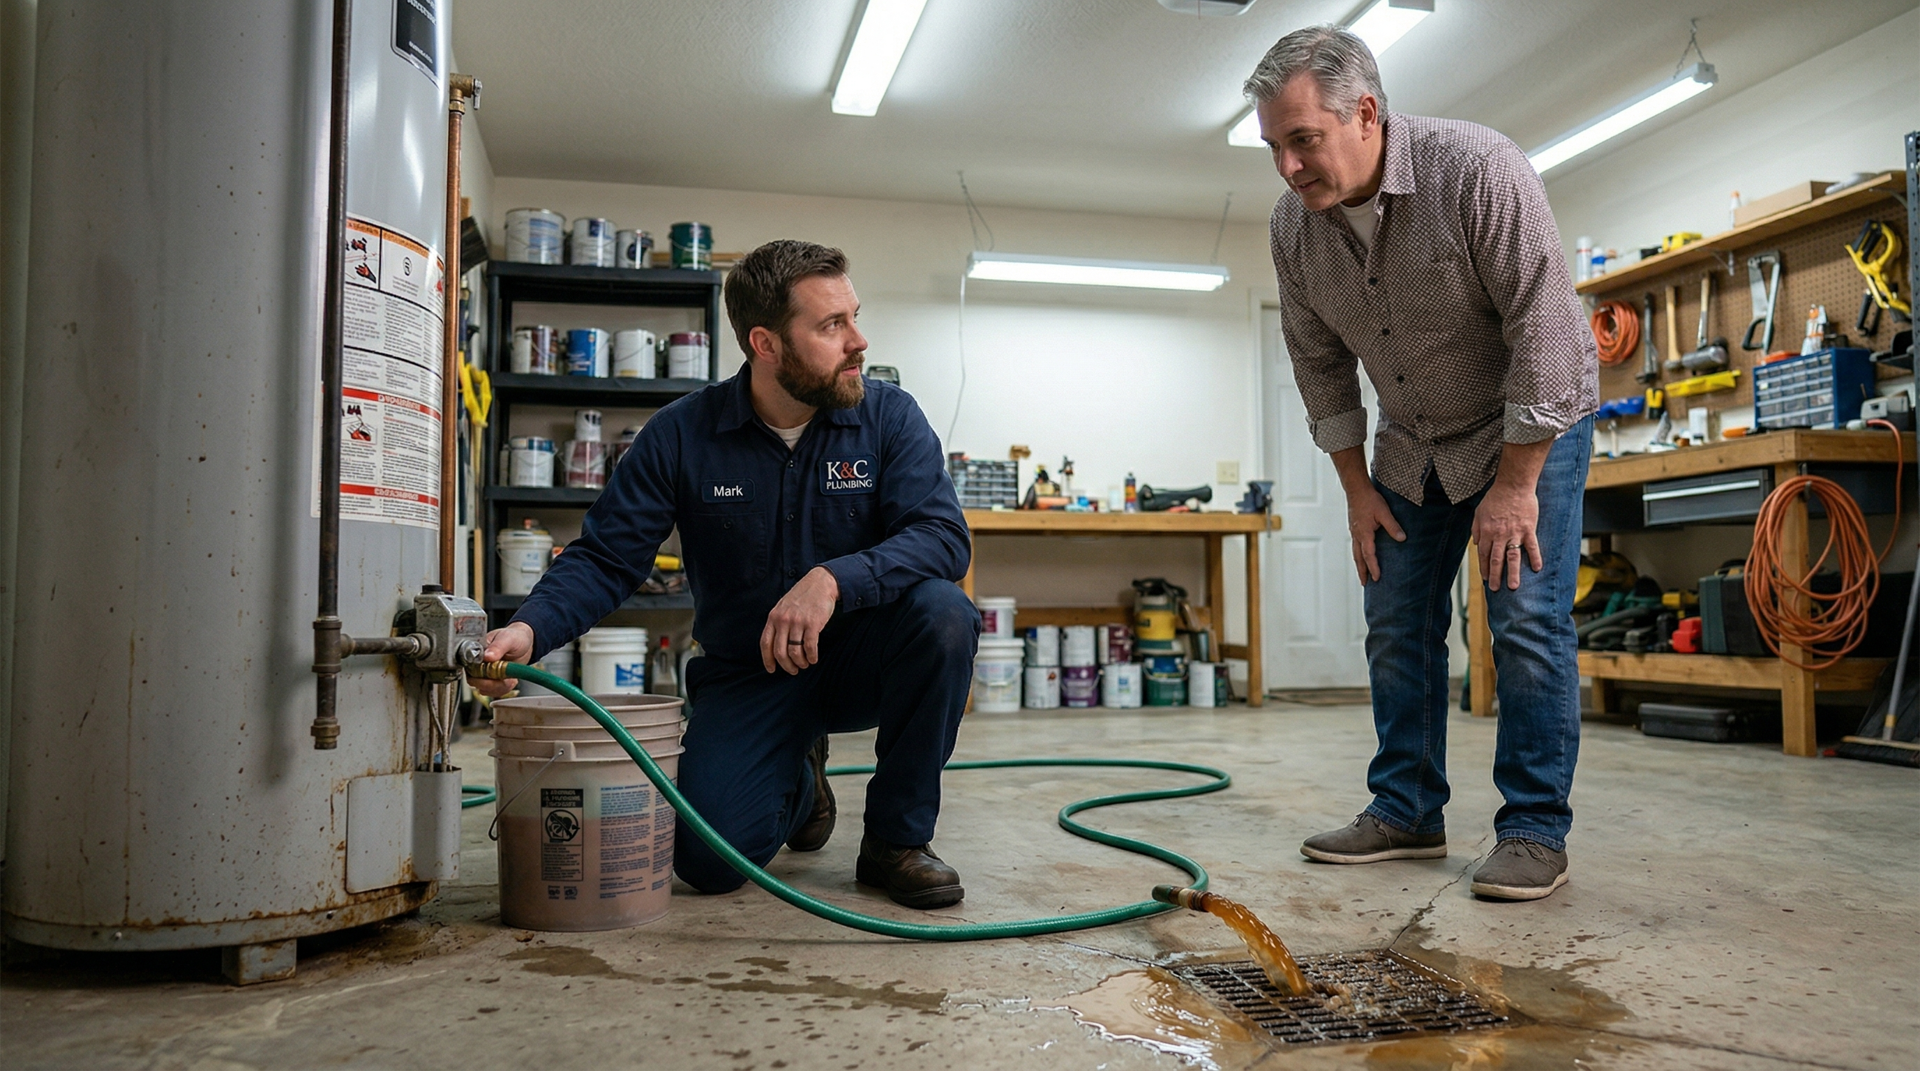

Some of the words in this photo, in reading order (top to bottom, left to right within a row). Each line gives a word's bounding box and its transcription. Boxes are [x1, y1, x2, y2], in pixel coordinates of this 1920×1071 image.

[826, 459, 869, 480] K&C
[826, 479, 873, 490] PLUMBING
[713, 485, 744, 497] Mark
